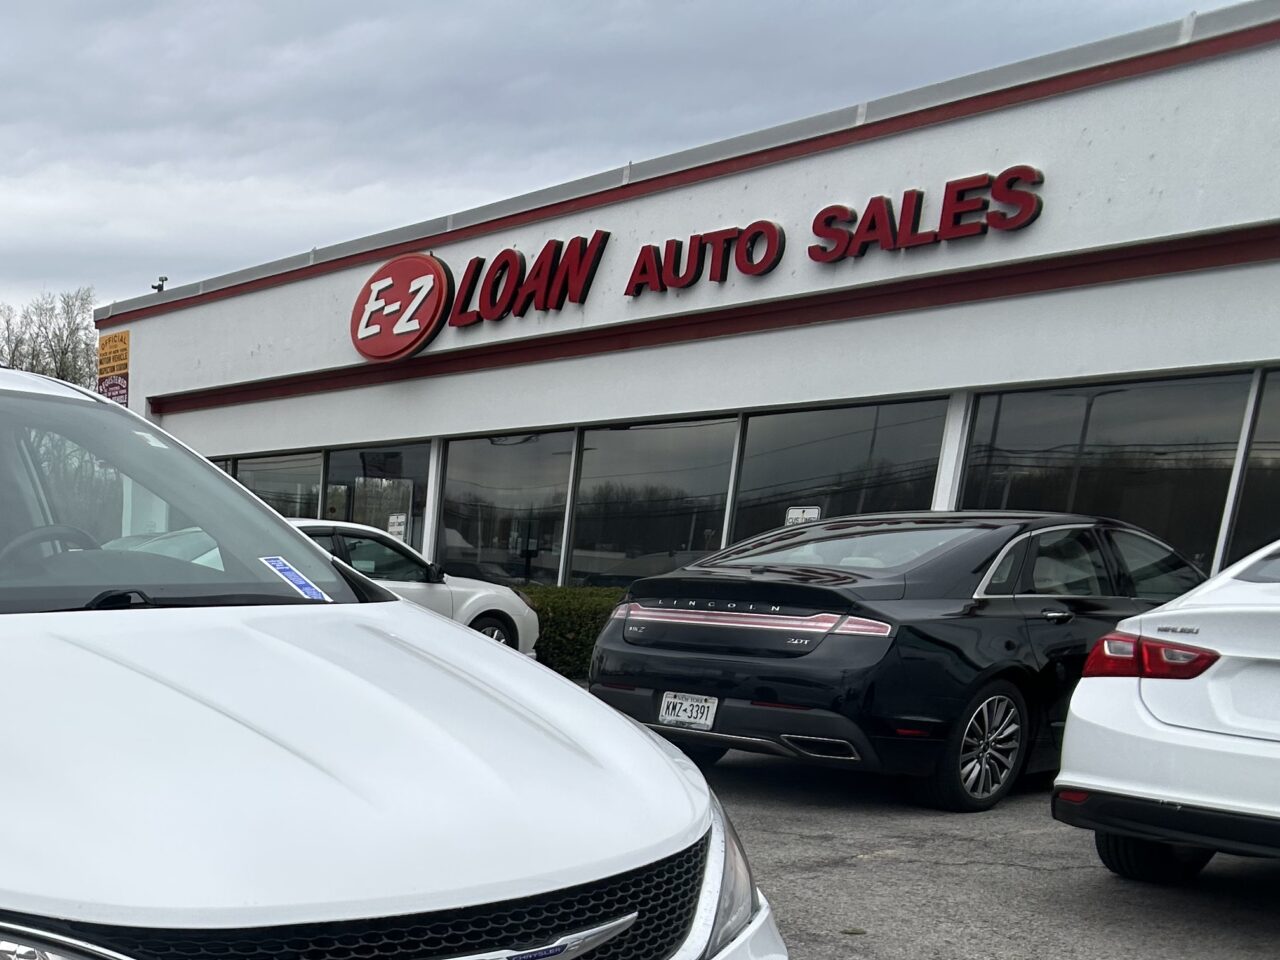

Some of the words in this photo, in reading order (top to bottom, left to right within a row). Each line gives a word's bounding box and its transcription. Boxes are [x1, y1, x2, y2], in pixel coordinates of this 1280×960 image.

[357, 274, 435, 340] E-Z
[448, 229, 611, 328] LOAN
[624, 219, 786, 297] AUTO
[808, 164, 1045, 264] SALES
[100, 333, 127, 351] OFFICIAL
[658, 599, 780, 612] LINCOLN
